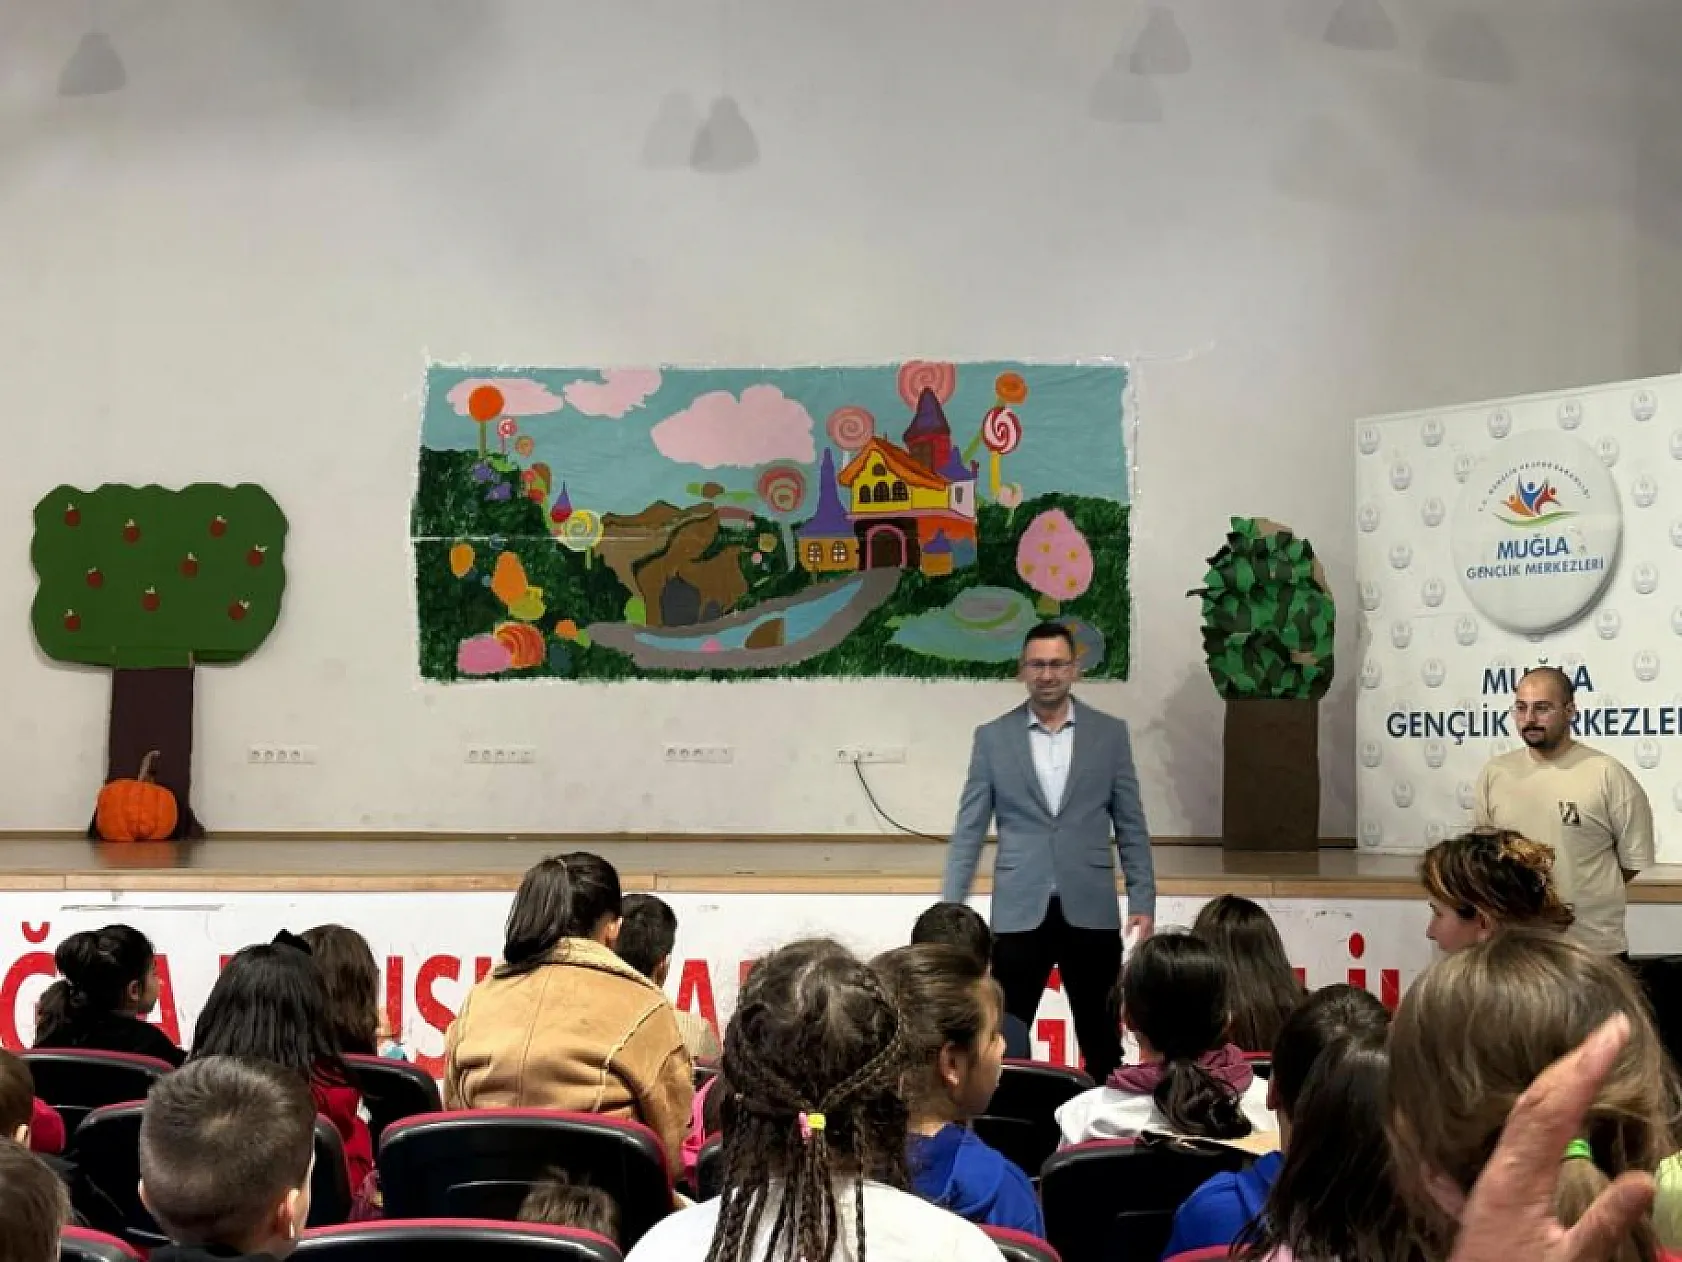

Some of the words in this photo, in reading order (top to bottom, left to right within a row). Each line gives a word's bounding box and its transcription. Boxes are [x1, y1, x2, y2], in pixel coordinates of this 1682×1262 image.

[1497, 533, 1570, 560] MUĞLA
[1466, 563, 1521, 580] GENÇLİK
[1525, 556, 1604, 577] MERKEZLERİ
[1386, 703, 1510, 745] GENÇLİK
